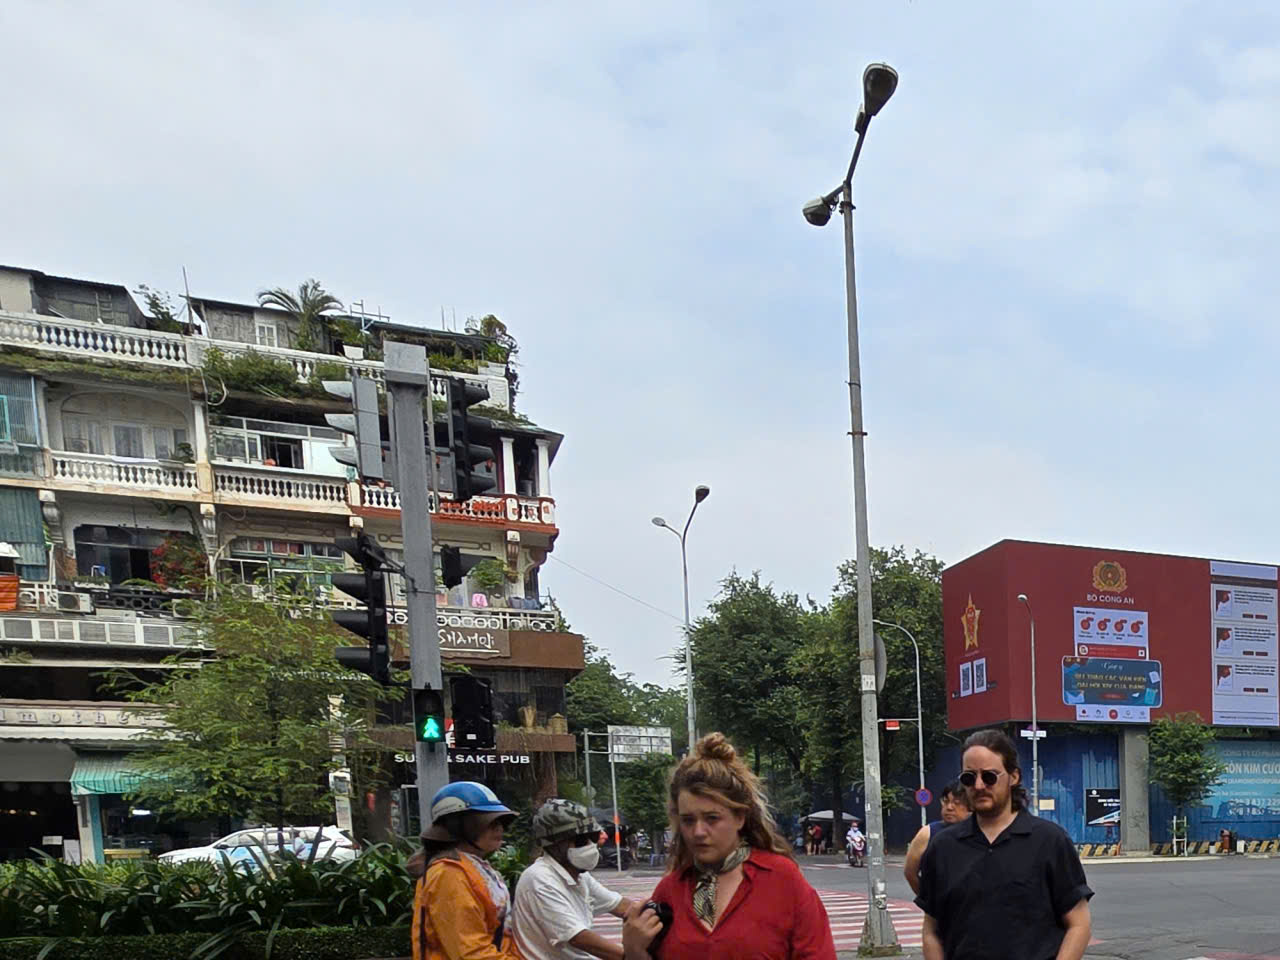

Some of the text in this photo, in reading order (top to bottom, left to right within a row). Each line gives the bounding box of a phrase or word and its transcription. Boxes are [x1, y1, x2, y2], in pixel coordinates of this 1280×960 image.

[455, 754, 497, 764] SAKE
[500, 755, 531, 764] PUB
[1243, 763, 1261, 774] KIM
